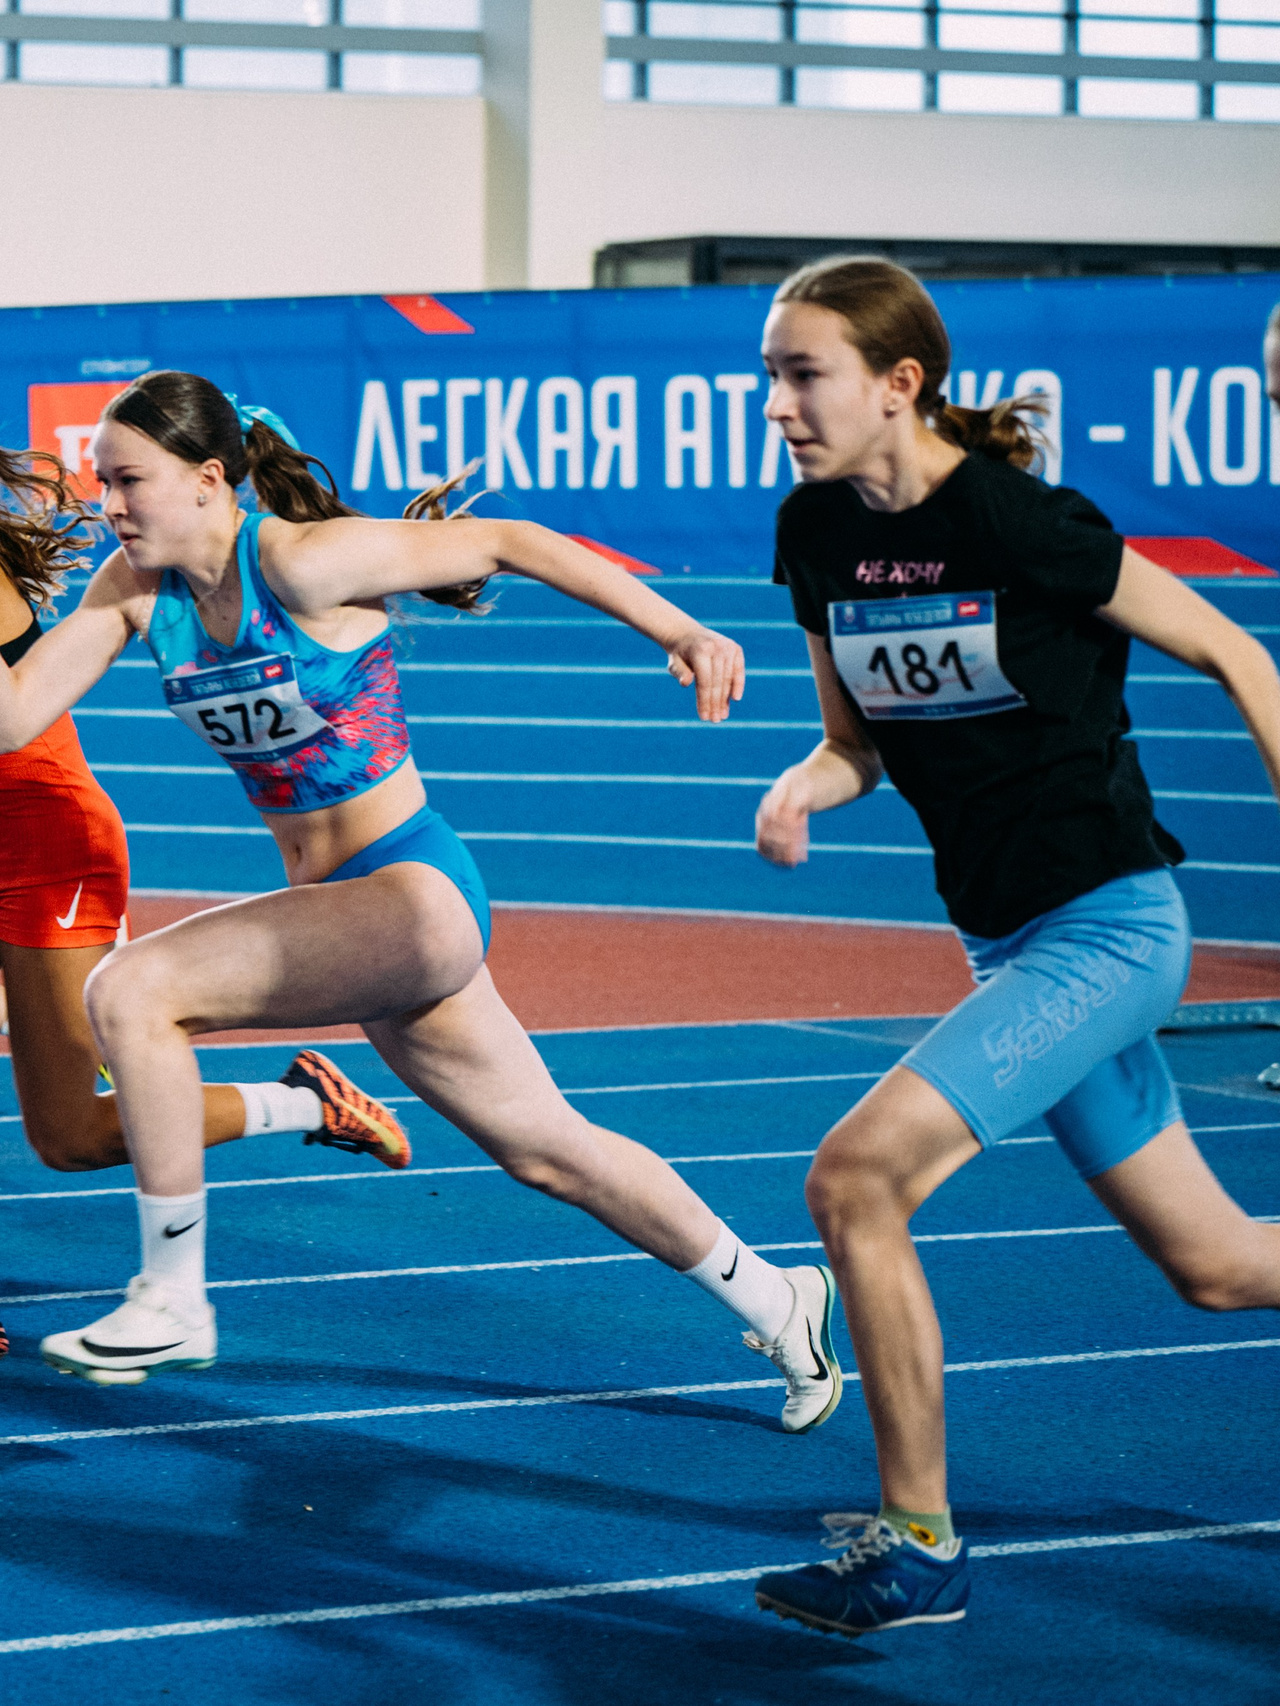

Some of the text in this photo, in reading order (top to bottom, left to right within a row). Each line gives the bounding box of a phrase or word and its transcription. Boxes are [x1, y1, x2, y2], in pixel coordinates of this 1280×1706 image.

[352, 375, 638, 491] ЛЕГКАЯ
[1153, 366, 1280, 487] КО
[868, 641, 974, 695] 181
[197, 698, 297, 746] 572
